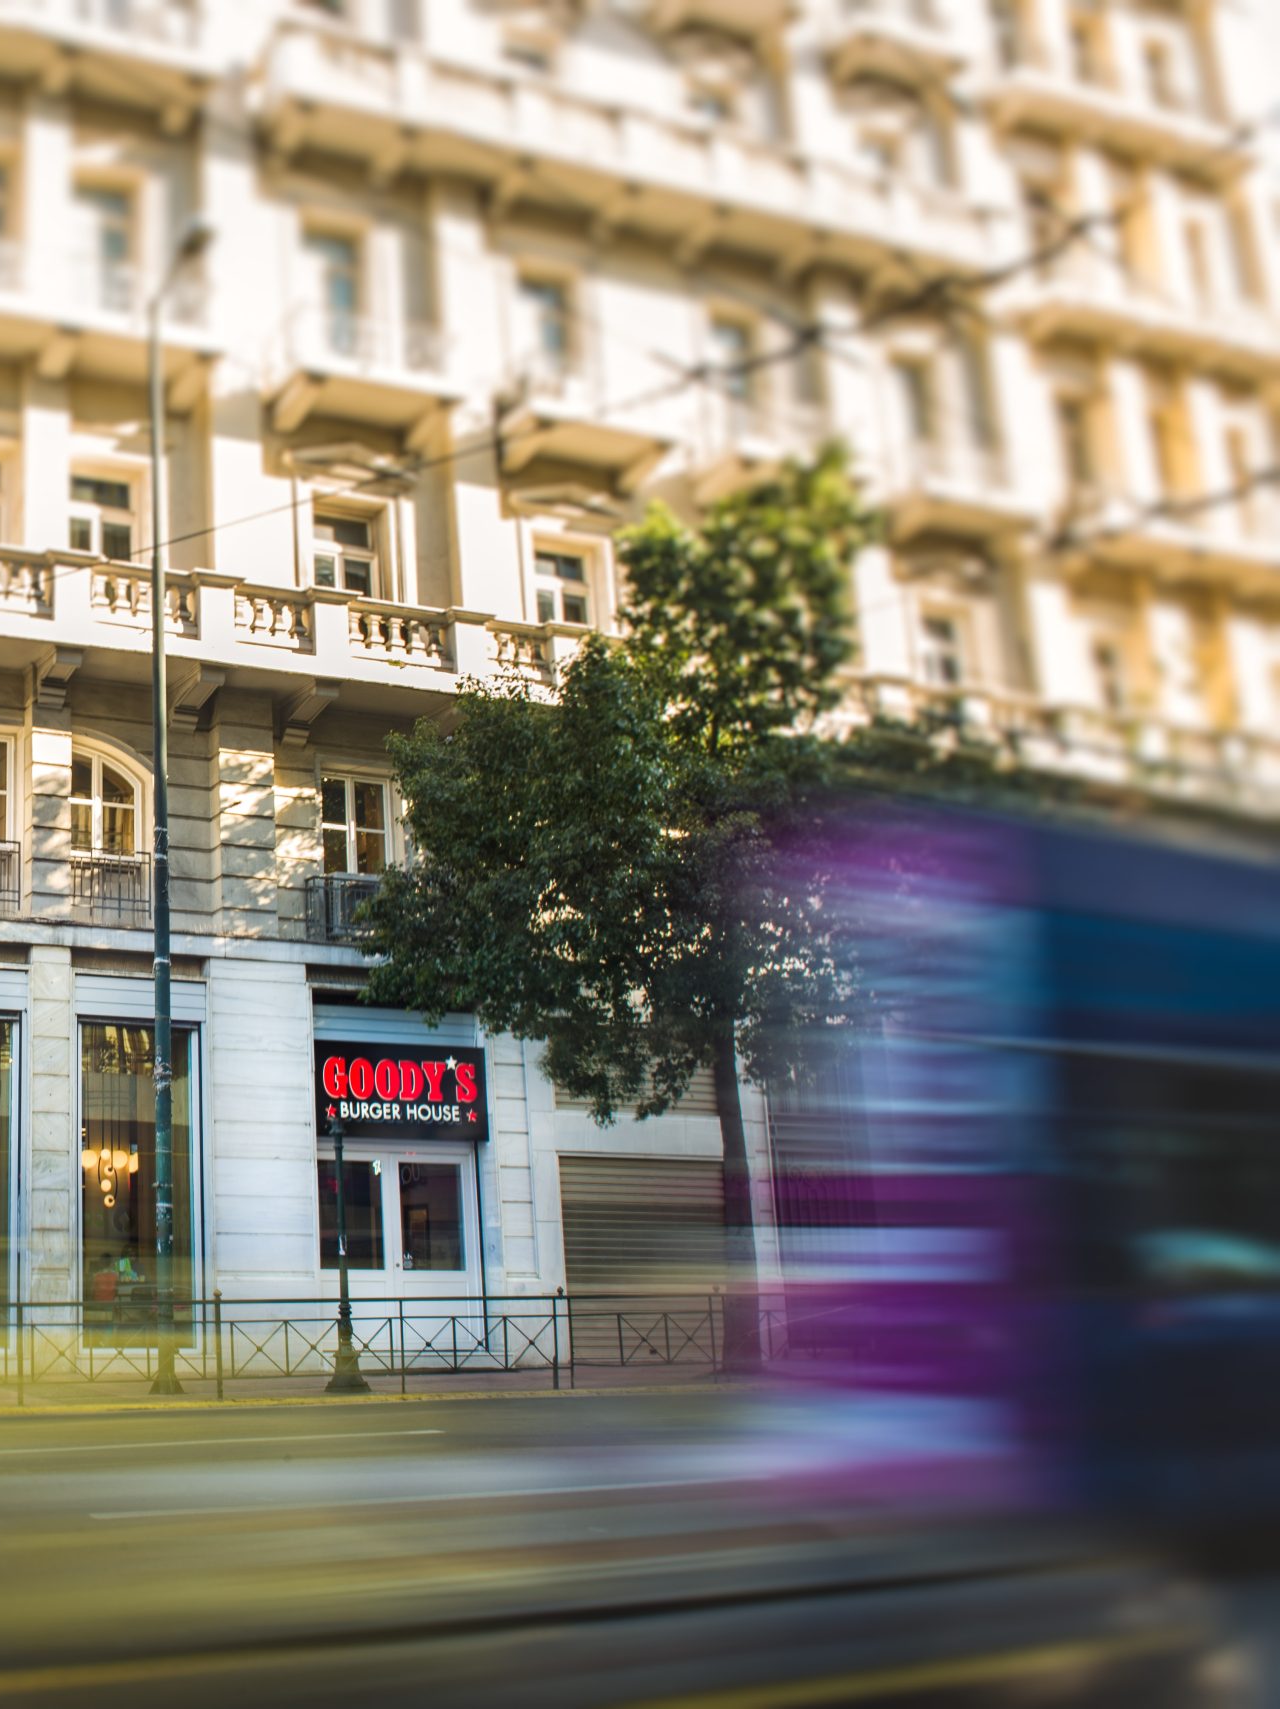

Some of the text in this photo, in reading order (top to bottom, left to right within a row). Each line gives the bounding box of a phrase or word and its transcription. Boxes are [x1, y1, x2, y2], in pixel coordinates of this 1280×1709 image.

[323, 1057, 477, 1102] GOODY'S
[340, 1101, 460, 1122] BURGER HOUSE
